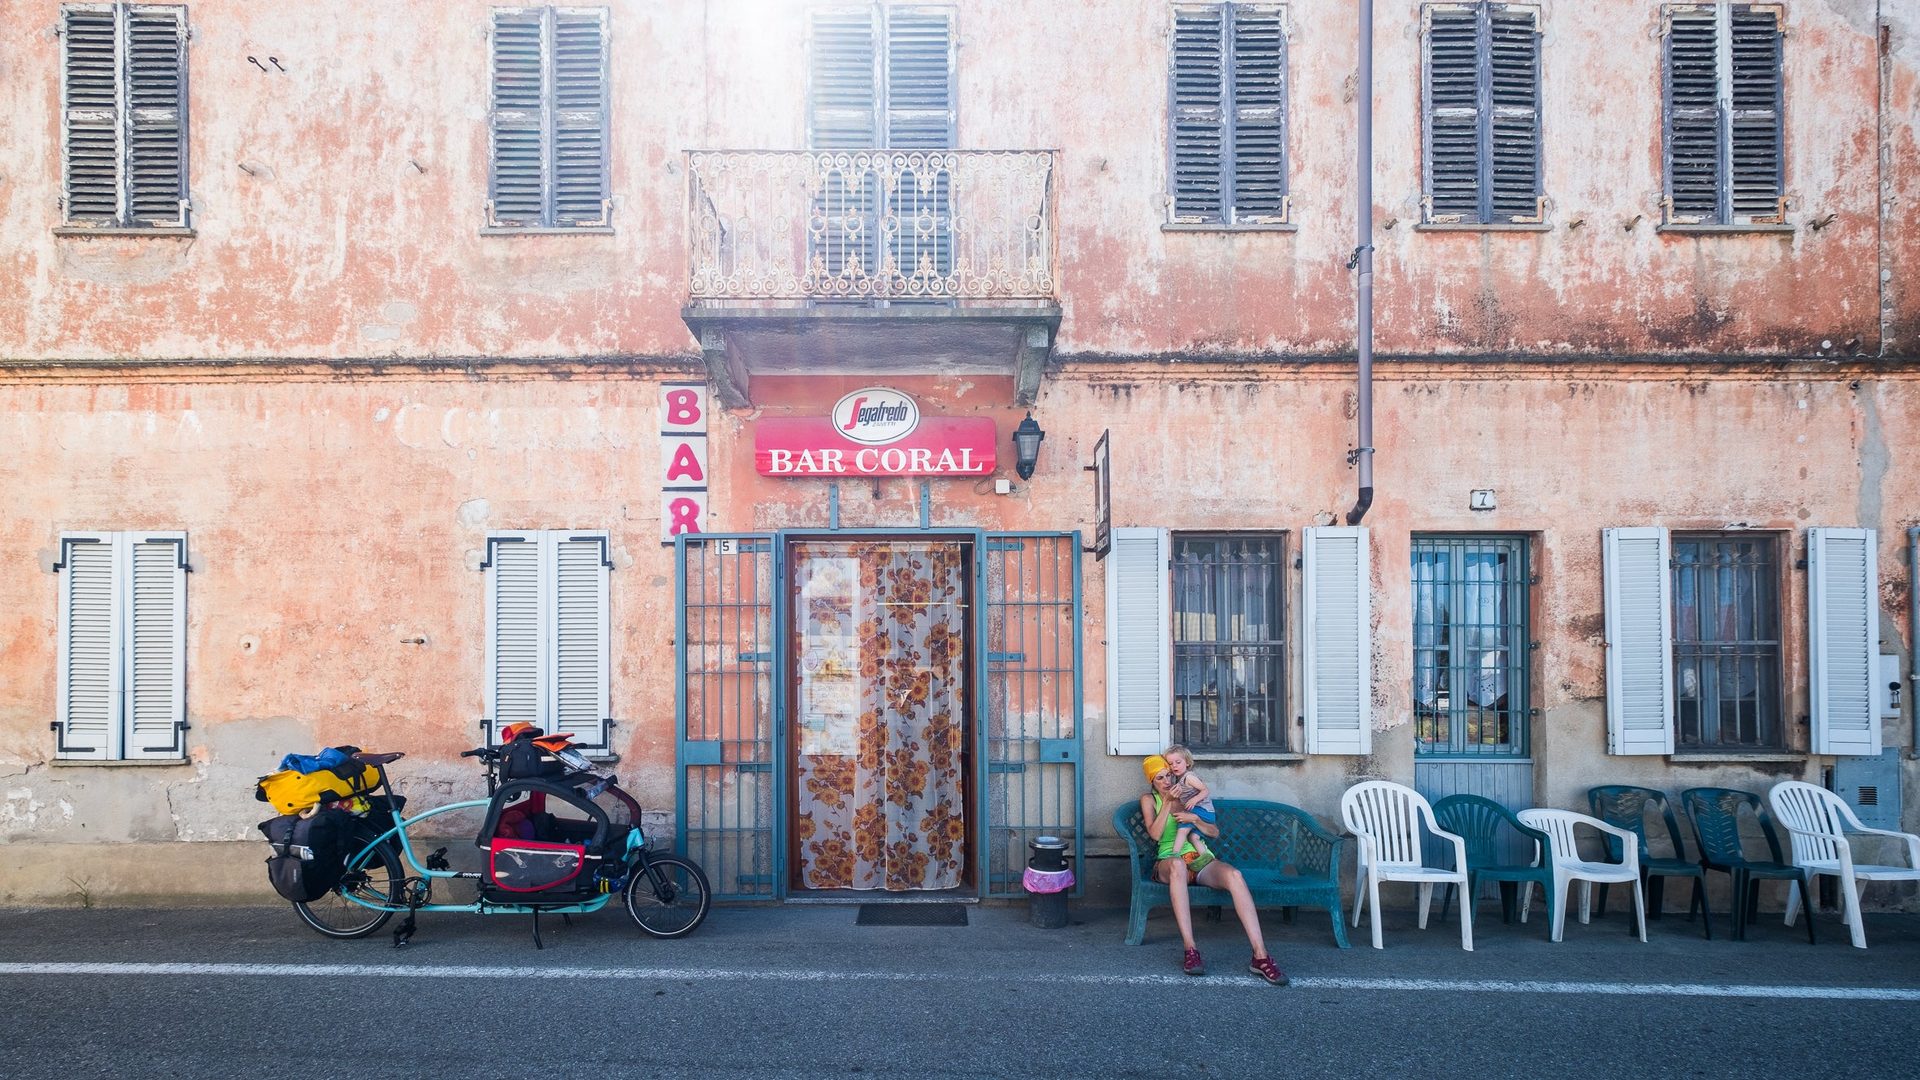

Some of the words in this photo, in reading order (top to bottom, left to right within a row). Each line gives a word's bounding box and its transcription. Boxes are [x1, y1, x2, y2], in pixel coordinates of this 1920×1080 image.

[843, 397, 908, 430] Segafredo
[666, 389, 704, 536] BAR
[768, 449, 845, 473] BAR
[855, 447, 983, 473] CORAL
[1479, 492, 1488, 506] 7
[722, 540, 730, 552] 5
